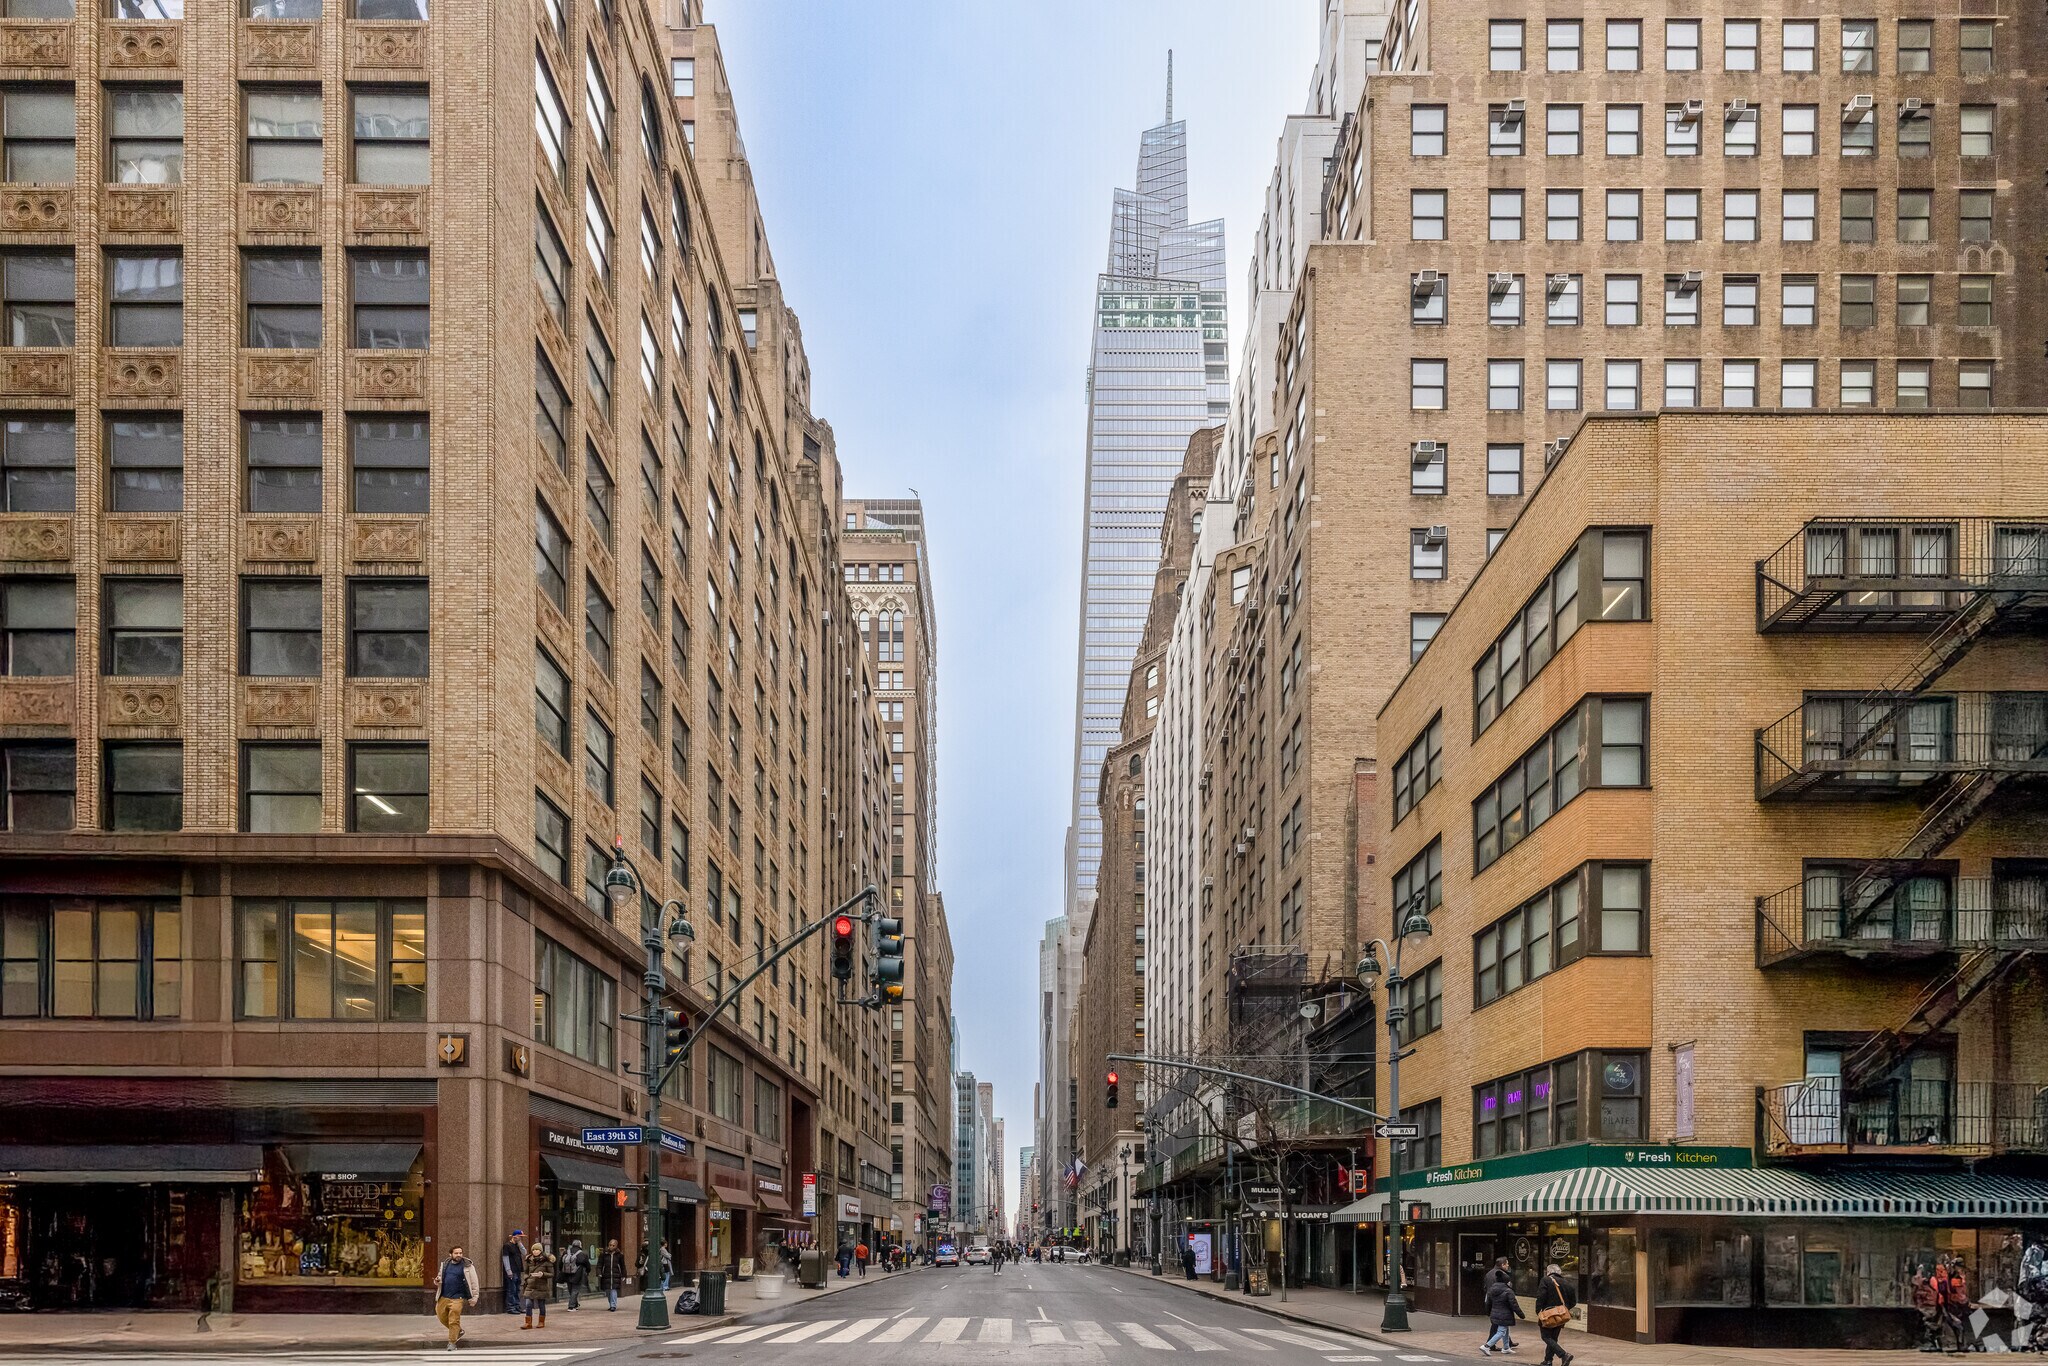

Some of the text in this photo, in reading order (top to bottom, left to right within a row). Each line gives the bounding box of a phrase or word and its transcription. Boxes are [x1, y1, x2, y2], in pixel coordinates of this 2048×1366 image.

[1603, 1116, 1636, 1125] PILATES
[586, 1131, 638, 1141] East 39th St
[661, 1133, 686, 1151] Madison Ave
[549, 1131, 565, 1145] PARK
[565, 1135, 586, 1149] AVEN
[605, 1145, 619, 1156] SHOP
[1638, 1152, 1718, 1163] Fresh Kitchen
[1432, 1167, 1483, 1183] Fresh Kitchen
